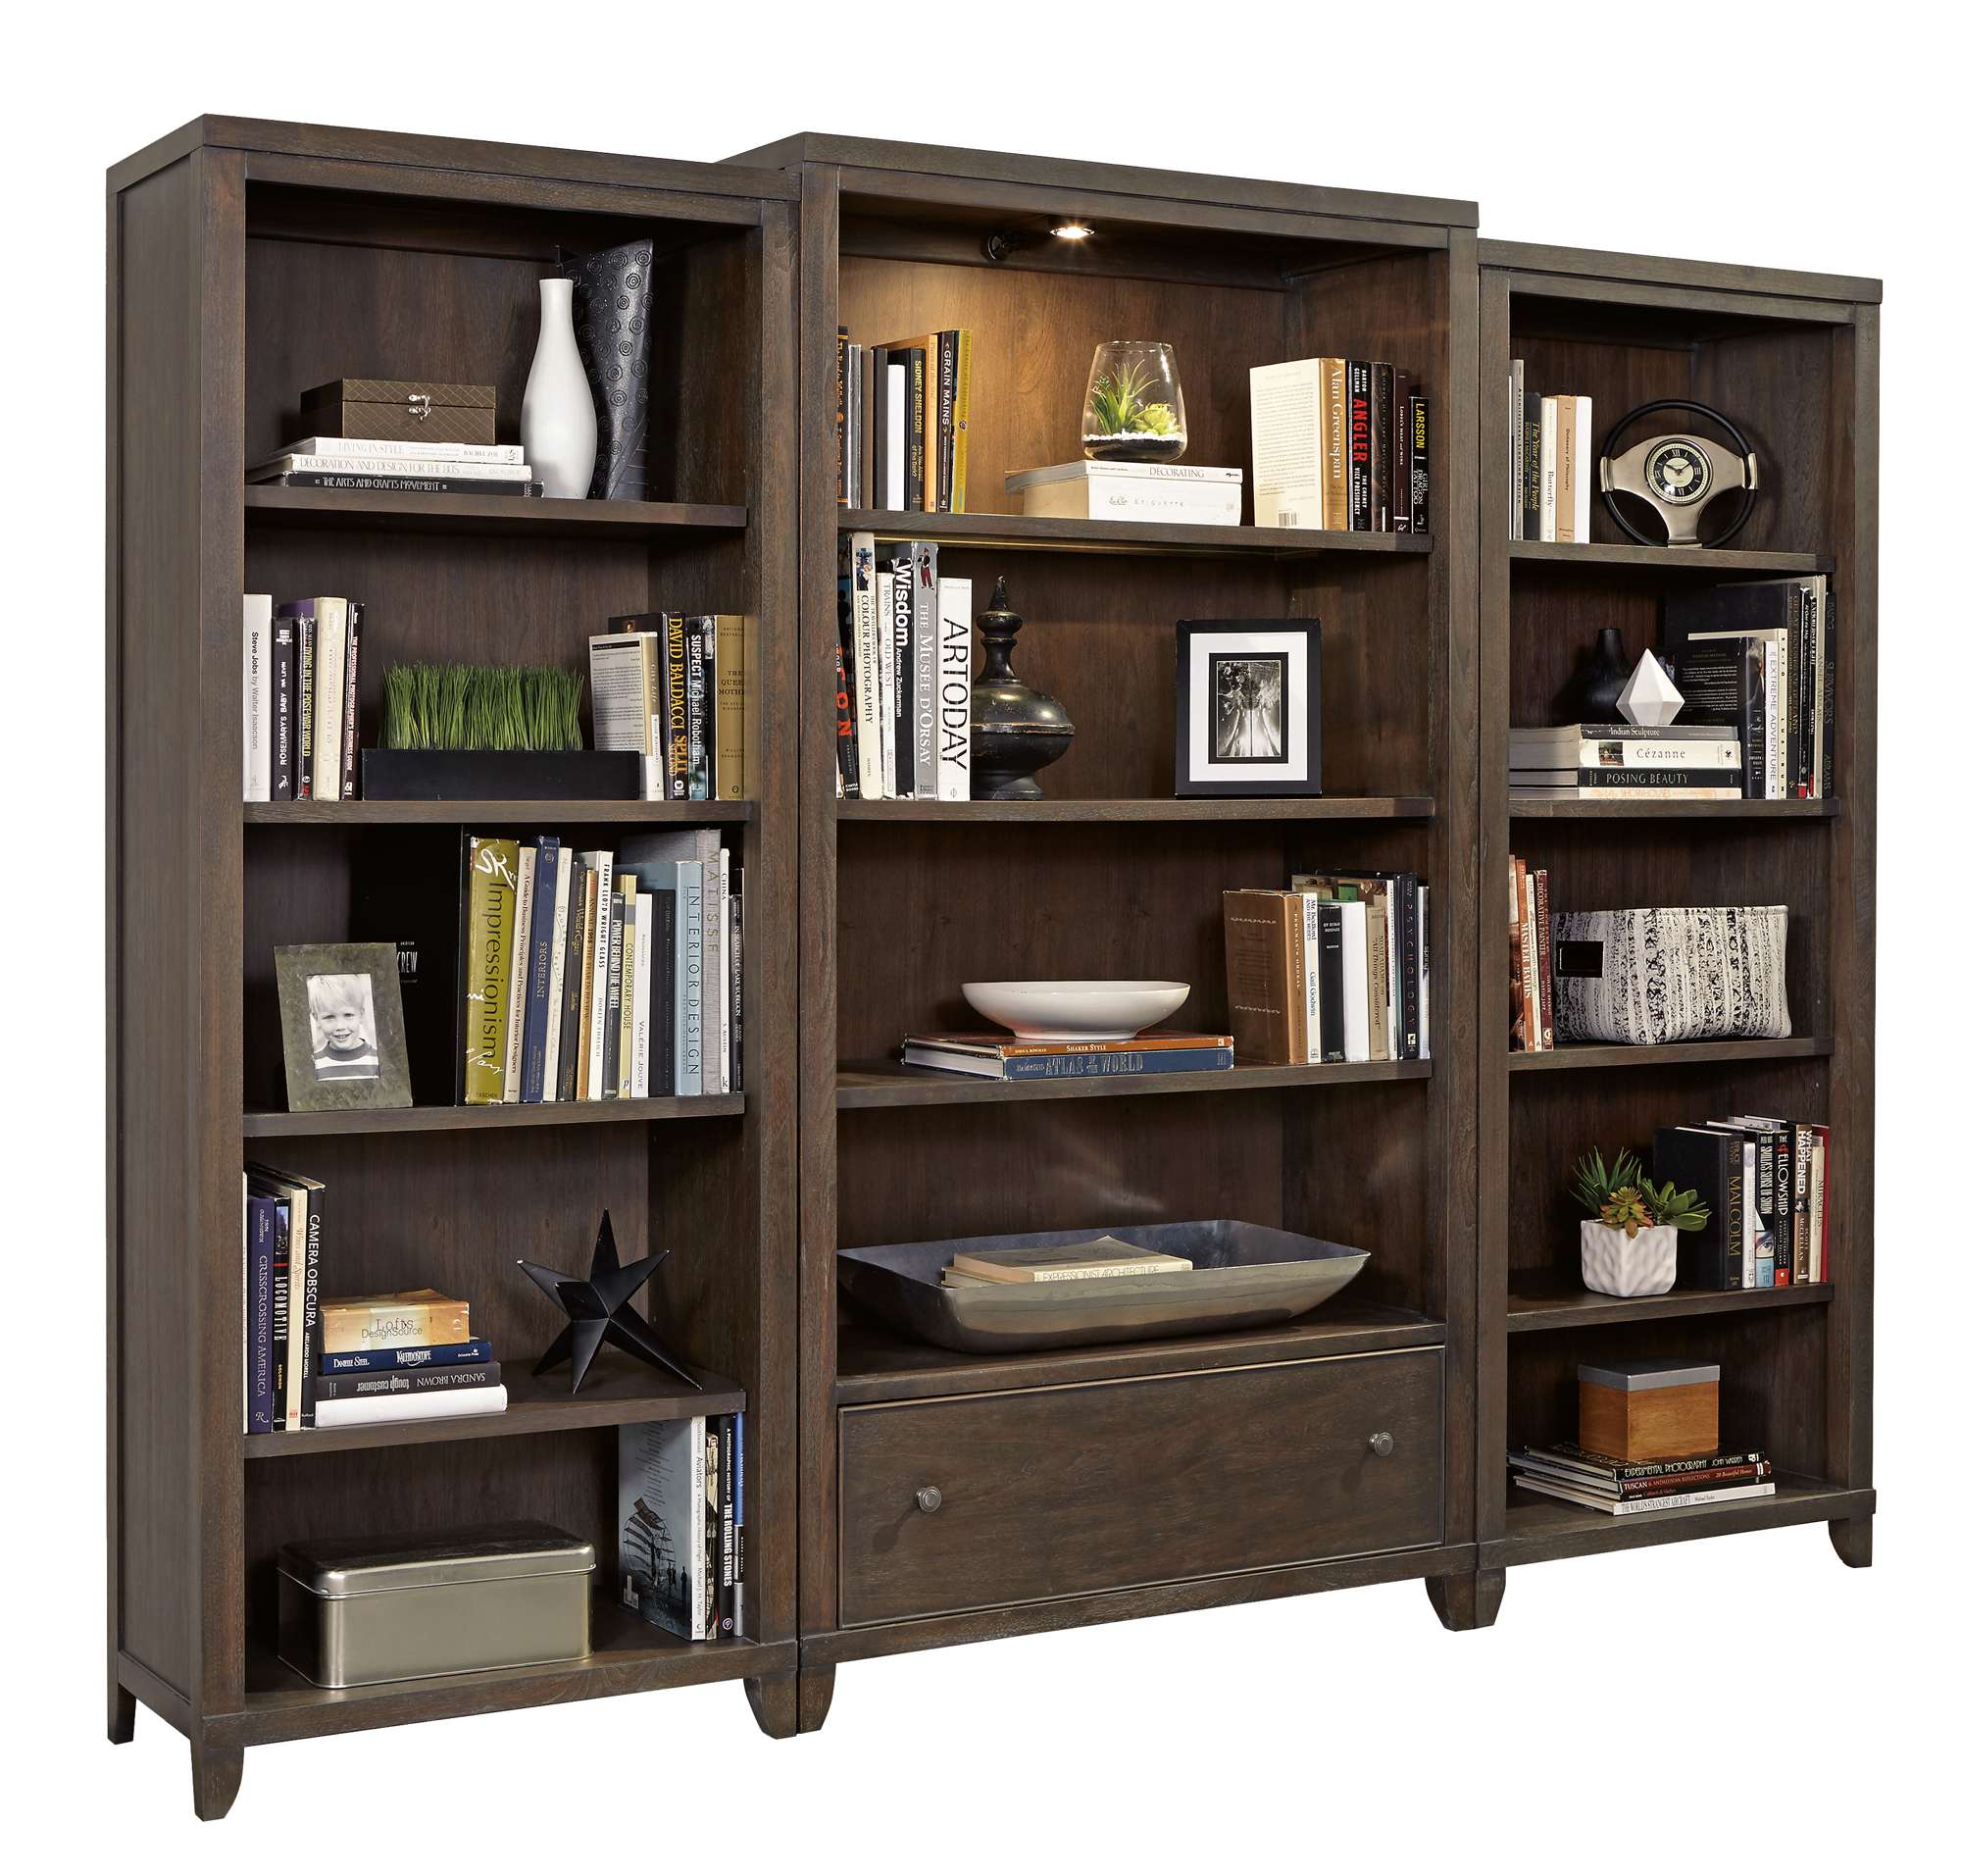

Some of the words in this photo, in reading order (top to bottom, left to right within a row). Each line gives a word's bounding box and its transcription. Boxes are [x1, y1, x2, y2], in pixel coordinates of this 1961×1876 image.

[913, 361, 923, 391] SIDNEY
[942, 350, 952, 385] GRAIN
[1332, 368, 1344, 399] Alan
[913, 393, 923, 433] SHELDON
[941, 389, 952, 426] MAINS
[1353, 398, 1368, 462] ANGLER
[1415, 402, 1426, 448] LARSSON
[1532, 422, 1540, 437] The
[1330, 403, 1344, 479] Greenspan
[1532, 438, 1540, 459] Year
[300, 458, 354, 471] DECORATION
[357, 460, 377, 472] AND
[377, 461, 407, 473] DESIGN
[1149, 467, 1205, 479] DECORATING
[1532, 471, 1540, 482] the
[323, 477, 334, 486] THE
[335, 478, 354, 487] ARTS
[356, 479, 372, 488] AND
[373, 479, 399, 490] CRAFTS
[400, 480, 440, 491] MOVEMENT
[1530, 485, 1540, 510] People
[1546, 471, 1555, 507] Butterfly
[861, 594, 871, 638] COLOUR
[883, 584, 892, 617] TRAINS
[894, 565, 913, 647] Wisdom
[920, 603, 930, 630] THE
[251, 632, 260, 653] Steve
[668, 618, 685, 658] DAVID
[251, 655, 260, 674] Jobs
[303, 647, 313, 668] DYING
[349, 647, 358, 684] PROFESSIONAL
[691, 634, 702, 677] SUSPECT
[919, 634, 935, 692] MUSÉE
[249, 677, 259, 685] by
[303, 679, 312, 690] THE
[863, 642, 874, 724] PHOTOGRAPHY
[884, 661, 893, 688] WEST
[670, 663, 685, 730] BALDACCI
[690, 680, 702, 716] Michael
[941, 618, 969, 771] ARTODAY
[1823, 660, 1835, 724] SURVIVORS
[302, 731, 311, 756] WORLD
[346, 731, 355, 753] BUSINESS
[690, 719, 702, 765] Robotham
[919, 697, 934, 767] D'ORSAY
[1610, 725, 1629, 735] Indian
[1632, 727, 1660, 738] Sculpture
[345, 754, 354, 772] GUIDE
[668, 743, 678, 777] SECOND
[675, 735, 688, 775] SPLIT
[1636, 746, 1686, 759] Cézanne
[1606, 772, 1647, 784] POSING
[1649, 772, 1688, 784] BEAUTY
[1536, 883, 1545, 925] DECORATIVE
[520, 907, 529, 934] Business
[612, 919, 623, 945] POWER
[517, 935, 528, 965] Principles
[688, 885, 701, 989] INTERIOR
[1521, 923, 1530, 963] MASTER
[1538, 927, 1547, 957] PAINTER
[481, 882, 509, 1059] Impressionism
[536, 941, 548, 998] INTERIORS
[611, 945, 623, 973] BEHIND
[624, 942, 633, 1002] CONTEMPORARY
[1372, 955, 1381, 980] Things
[1406, 903, 1416, 1025] PSYCHOLOGY
[515, 980, 524, 1008] Practices
[611, 974, 621, 987] THE
[1523, 966, 1532, 999] BATHS
[609, 987, 621, 1010] WHEEL
[623, 1005, 632, 1031] HOUSE
[637, 1021, 646, 1058] VALÉRIE
[688, 998, 700, 1076] DESIGN
[1066, 1043, 1088, 1052] SHAKER
[510, 1043, 520, 1074] Designers
[1045, 1056, 1083, 1076] ATLAS
[1102, 1054, 1143, 1073] WORLD
[1760, 1145, 1774, 1170] SMILLA'S
[1796, 1130, 1807, 1194] HAPPENED
[1776, 1143, 1789, 1216] FELLOWSHIP
[1729, 1176, 1742, 1256] MALCOLM
[307, 1214, 321, 1266] CAMERA
[258, 1255, 269, 1344] CRISSCROSSING
[274, 1277, 288, 1342] LOCOMOTIVE
[305, 1268, 319, 1328] OBSCURA
[303, 1332, 312, 1358] ABELARDO
[362, 1326, 424, 1340] DesignSource
[256, 1344, 268, 1397] AMERICA
[354, 1355, 371, 1368] STEEL
[395, 1349, 431, 1364] KALEIDOSCOPE
[356, 1380, 389, 1394] customer
[417, 1375, 449, 1388] BROWN
[451, 1372, 486, 1385] SANDRA
[695, 1456, 704, 1489] Aviators
[1665, 1458, 1707, 1473] PHOTOGRAPHY
[1624, 1481, 1647, 1491] TUSCAN
[724, 1503, 733, 1519] THE
[724, 1520, 733, 1553] ROLLING
[724, 1554, 733, 1587] STONES
